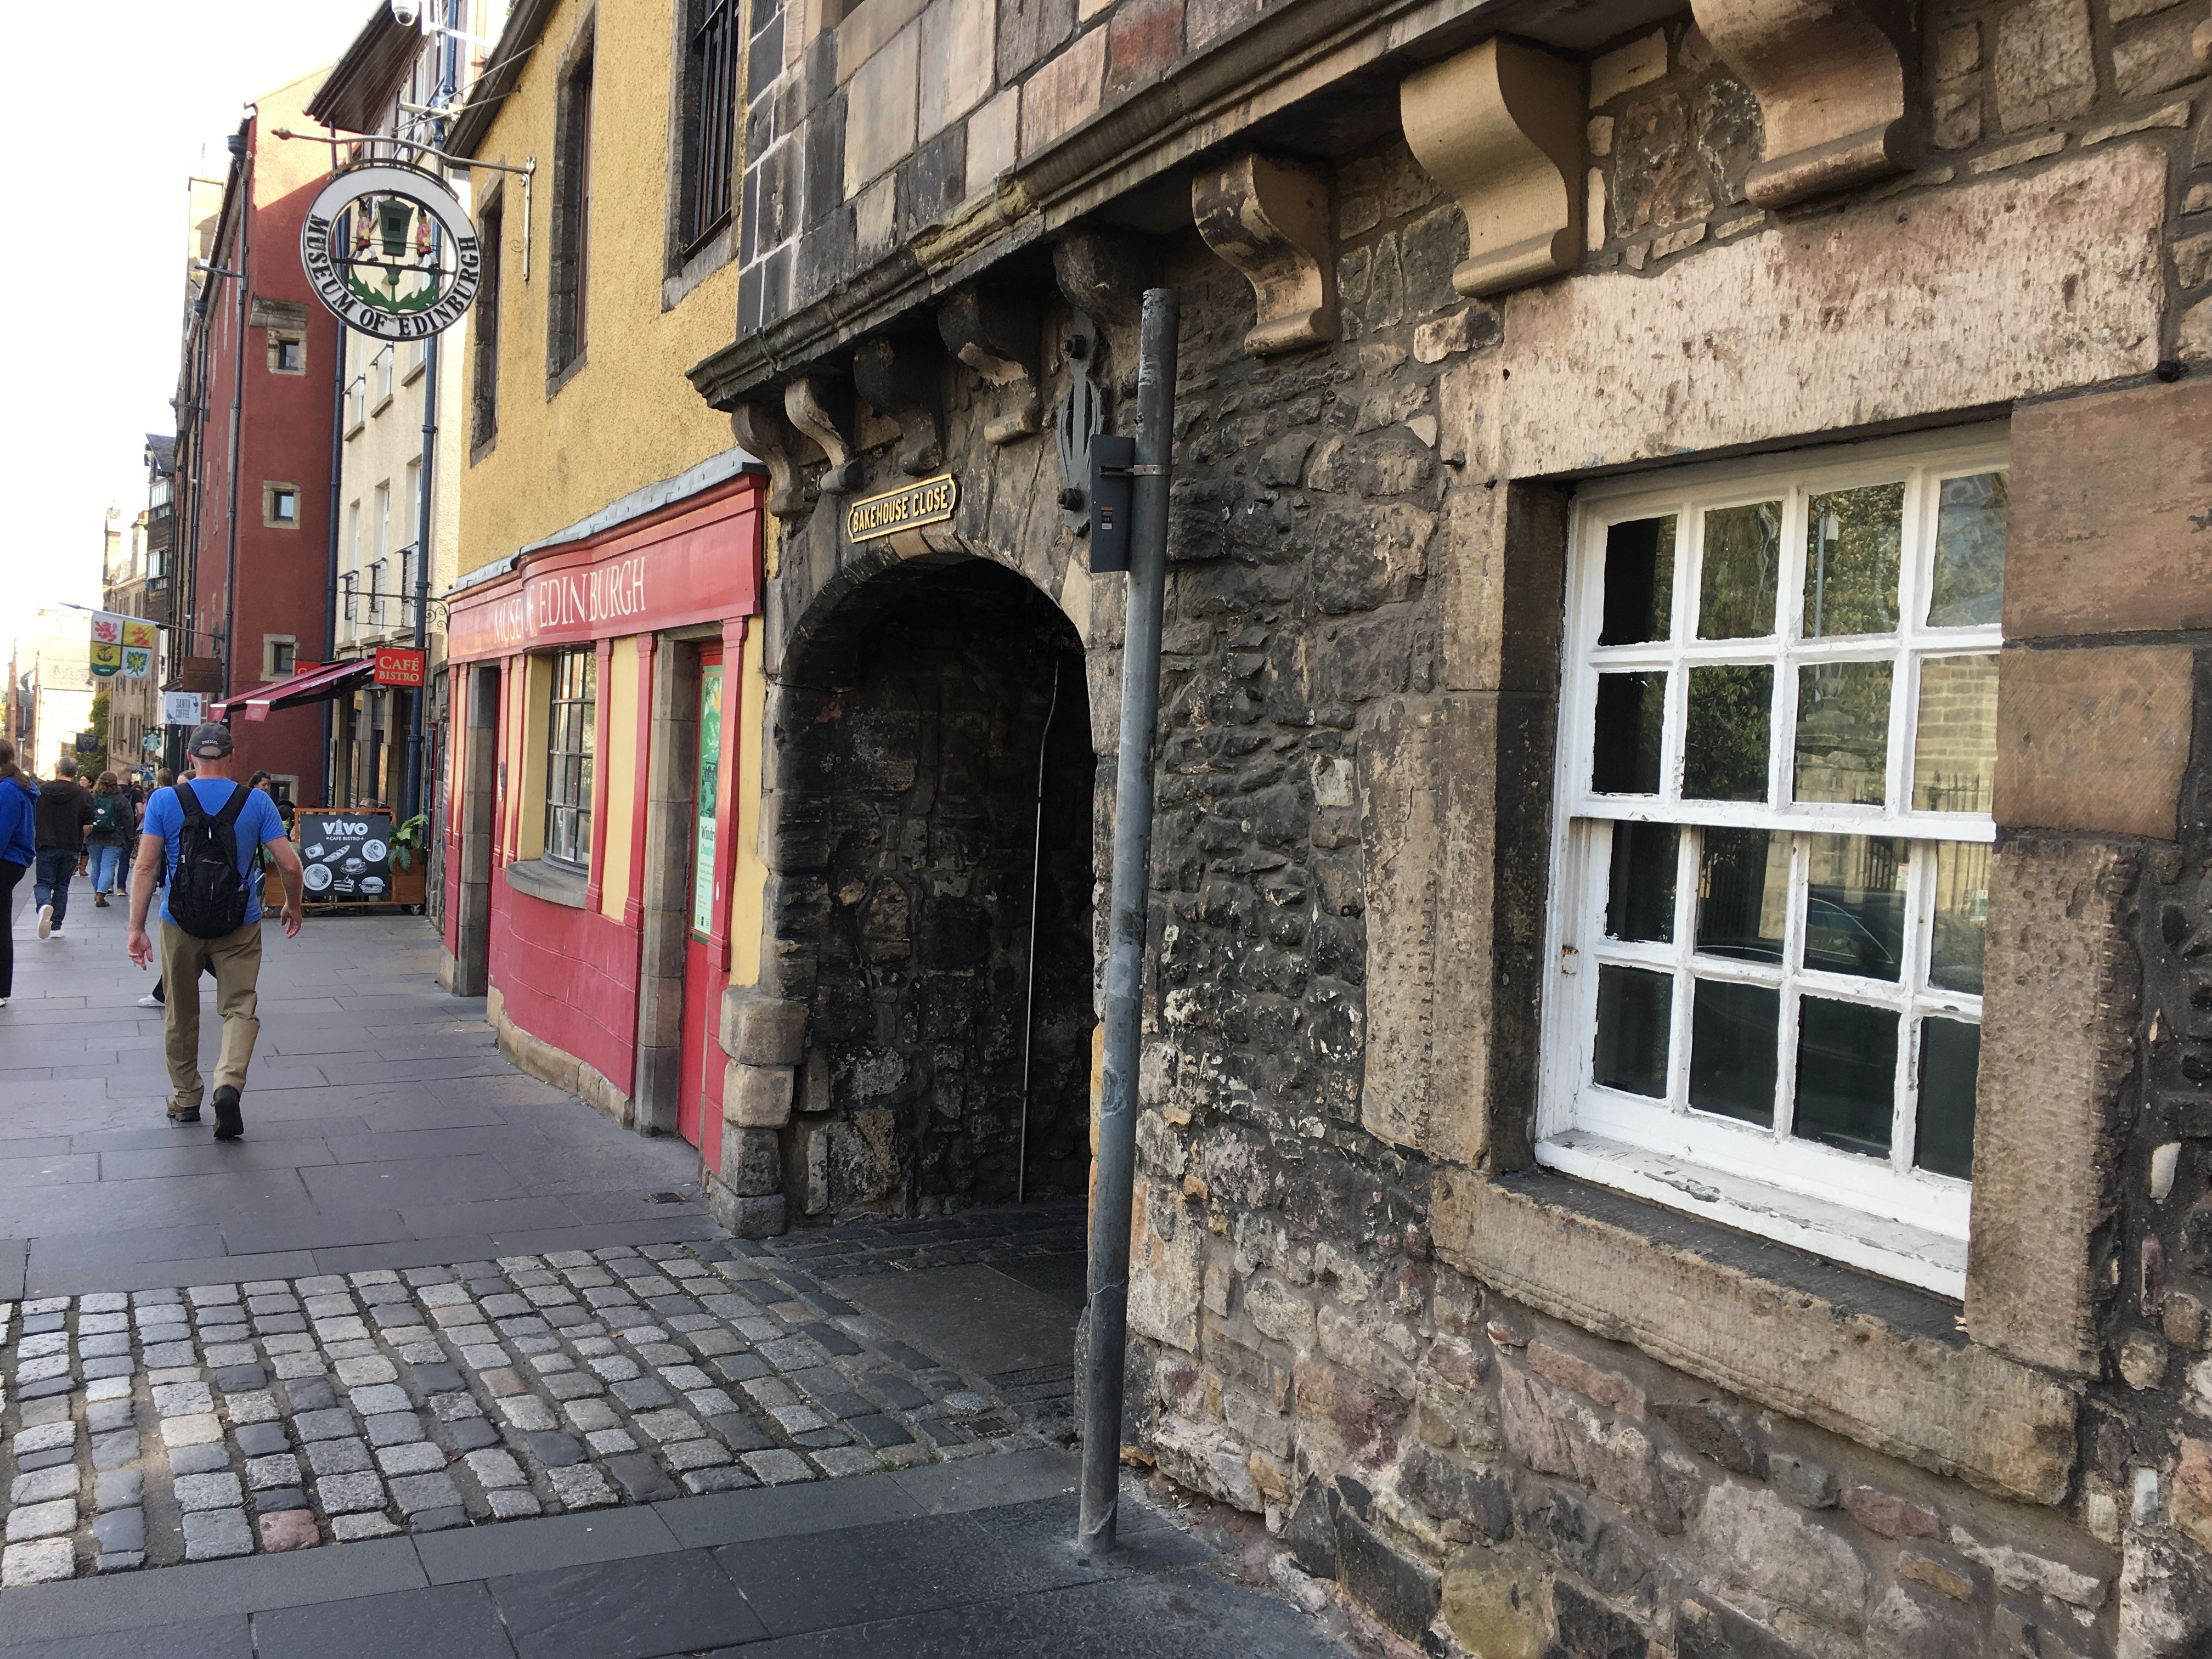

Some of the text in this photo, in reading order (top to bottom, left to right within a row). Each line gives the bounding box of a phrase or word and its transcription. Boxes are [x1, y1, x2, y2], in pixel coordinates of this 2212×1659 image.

[306, 213, 479, 336] MUSEUM OF EDINBURGH
[853, 485, 949, 533] BAKEHOUSE CLOSE
[523, 584, 535, 632] OF
[539, 556, 646, 628] EDINBURGH
[379, 656, 420, 672] CAFÉ
[379, 670, 420, 682] BISTRO
[176, 709, 190, 719] COFFEE
[322, 818, 369, 836] VIVO
